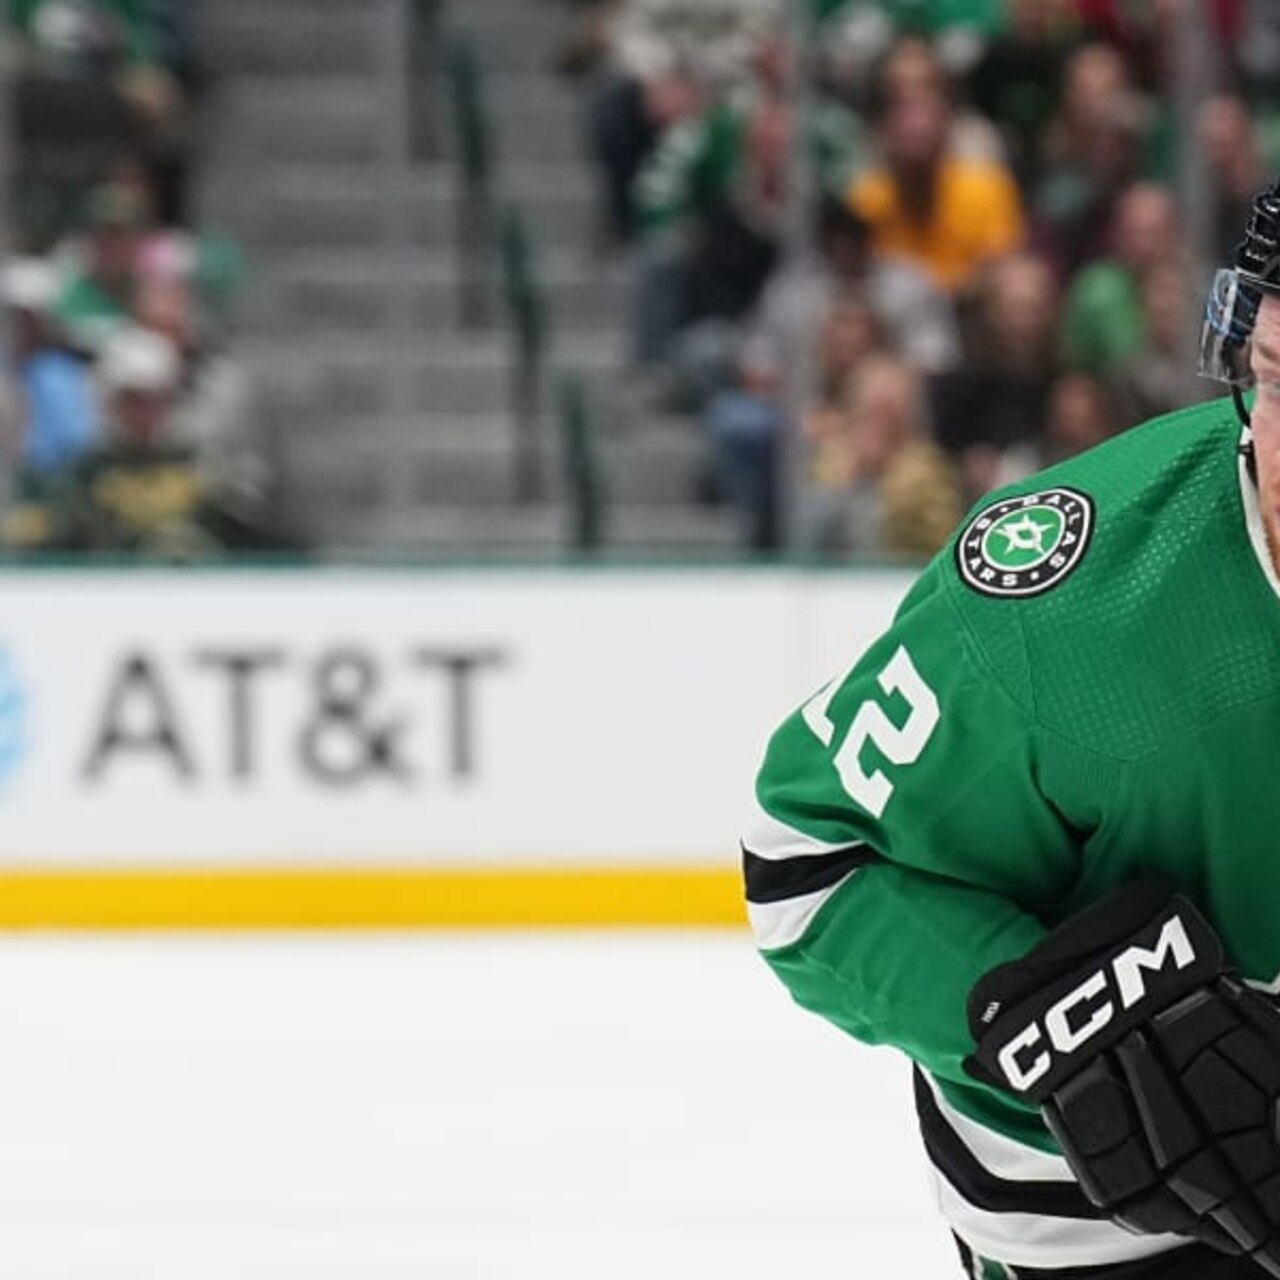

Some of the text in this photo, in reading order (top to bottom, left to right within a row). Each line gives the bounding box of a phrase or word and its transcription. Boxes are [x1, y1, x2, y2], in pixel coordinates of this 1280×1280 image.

[967, 517, 1019, 587] STARS
[1022, 494, 1082, 569] DALLAS
[78, 648, 510, 785] AT&T
[998, 914, 1196, 1092] CCM
